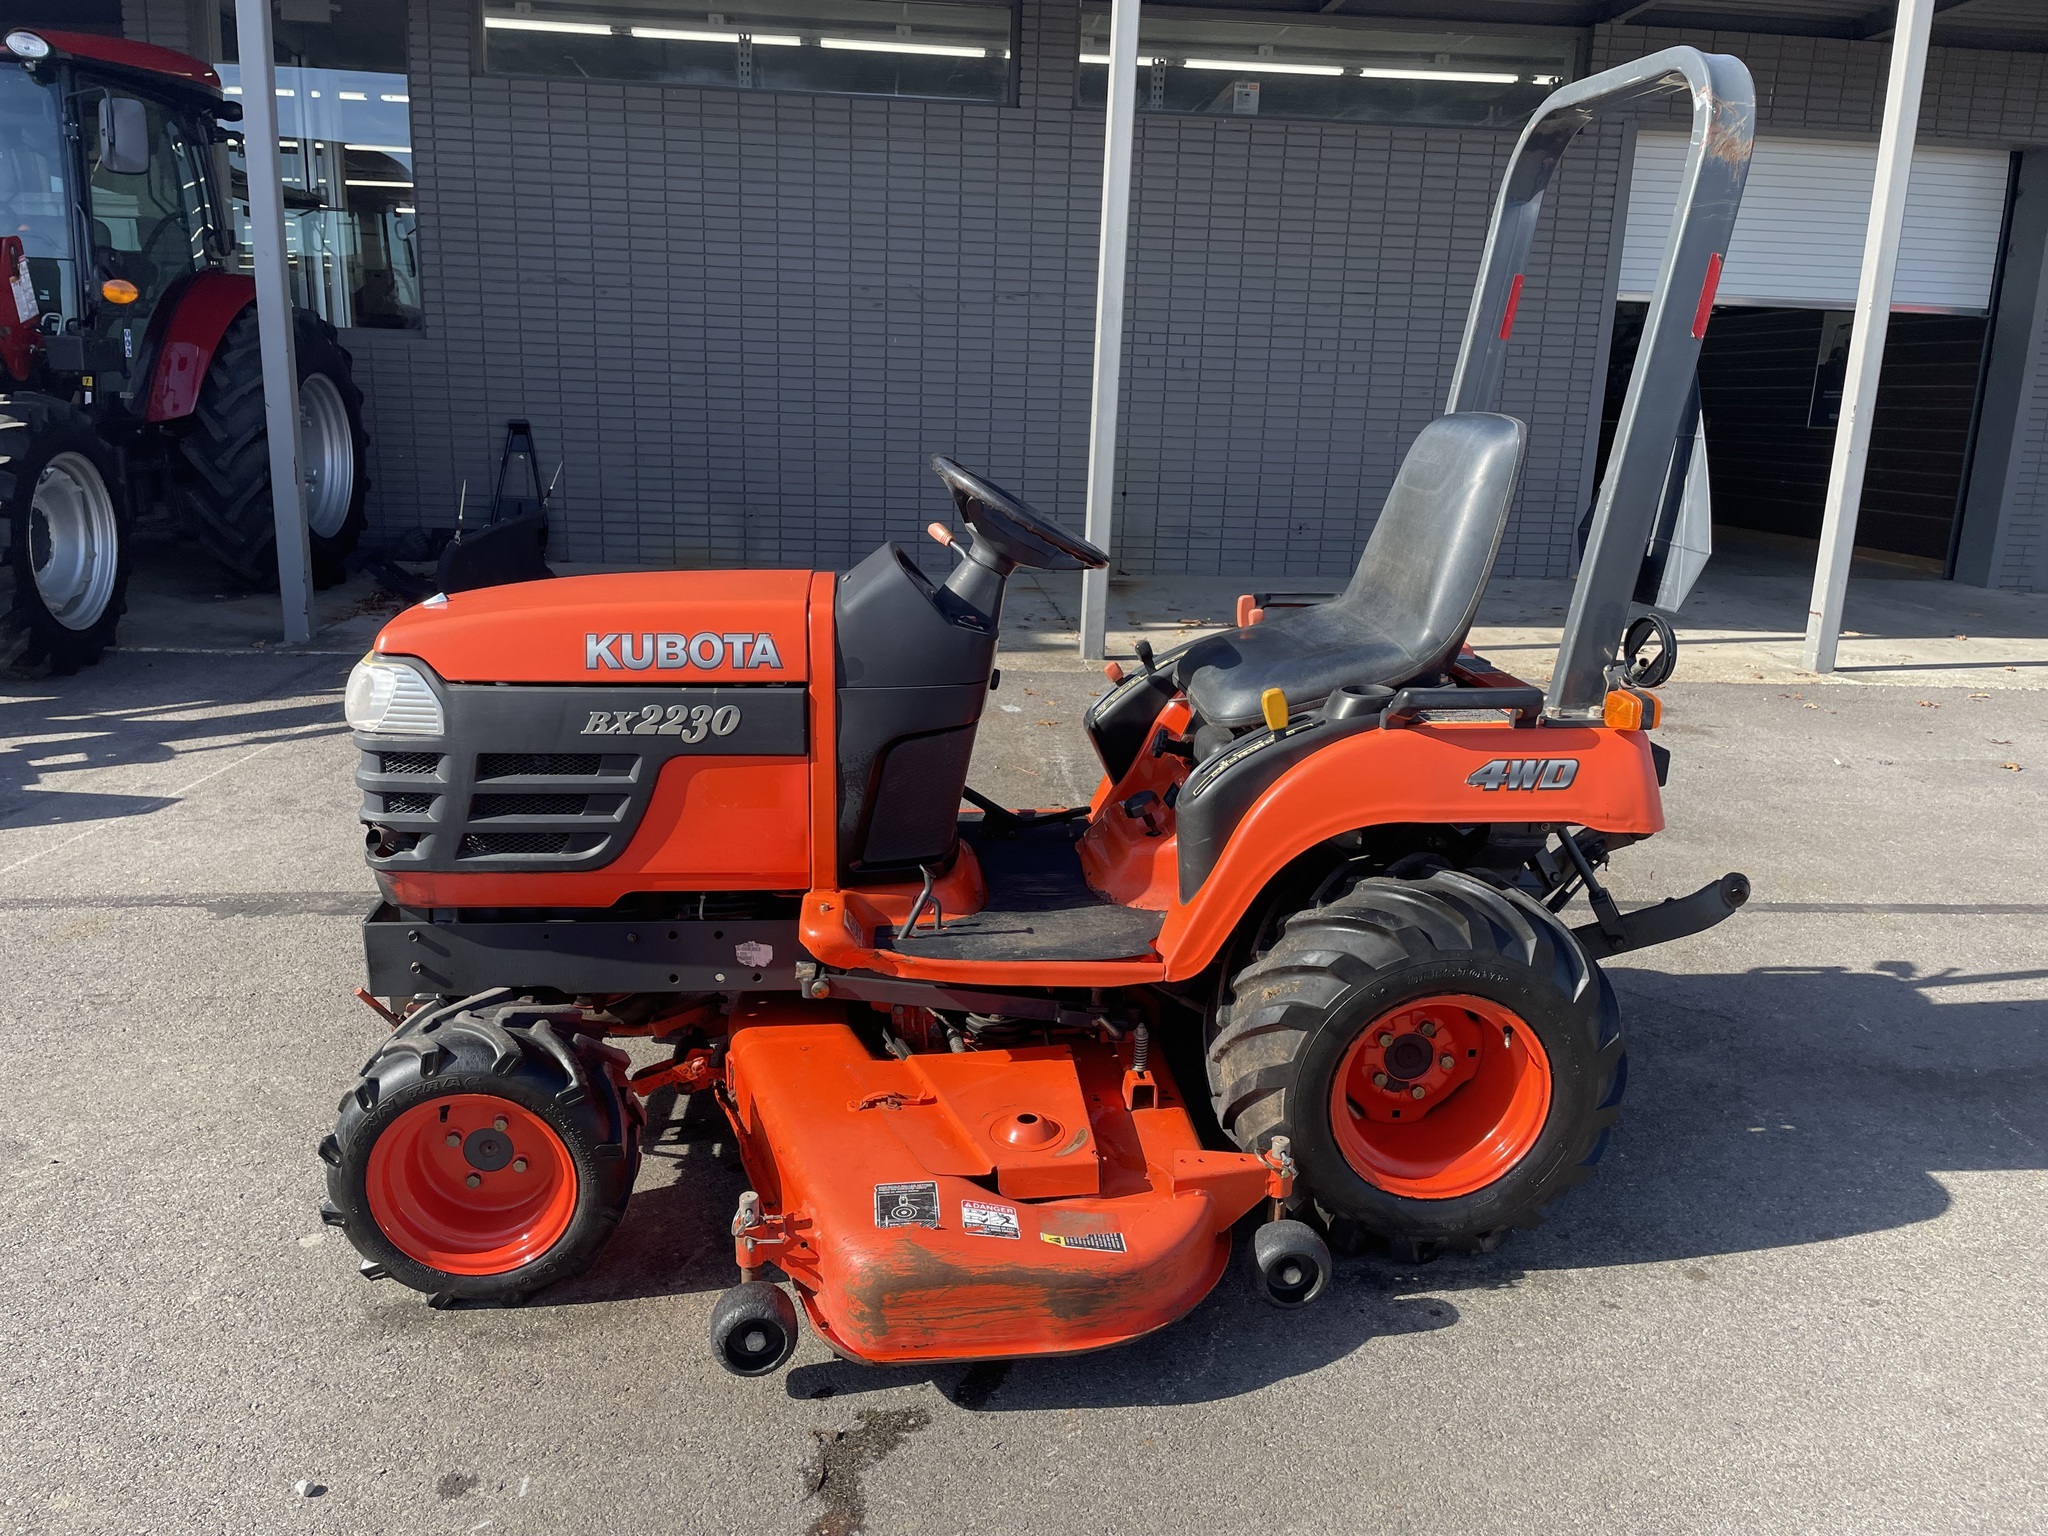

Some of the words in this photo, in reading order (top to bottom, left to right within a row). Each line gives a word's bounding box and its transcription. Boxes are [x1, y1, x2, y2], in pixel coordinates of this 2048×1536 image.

[585, 632, 784, 671] KUBOTA
[579, 703, 742, 745] BX2230
[1466, 758, 1580, 791] 4WD
[972, 1202, 1015, 1215] DANGER
